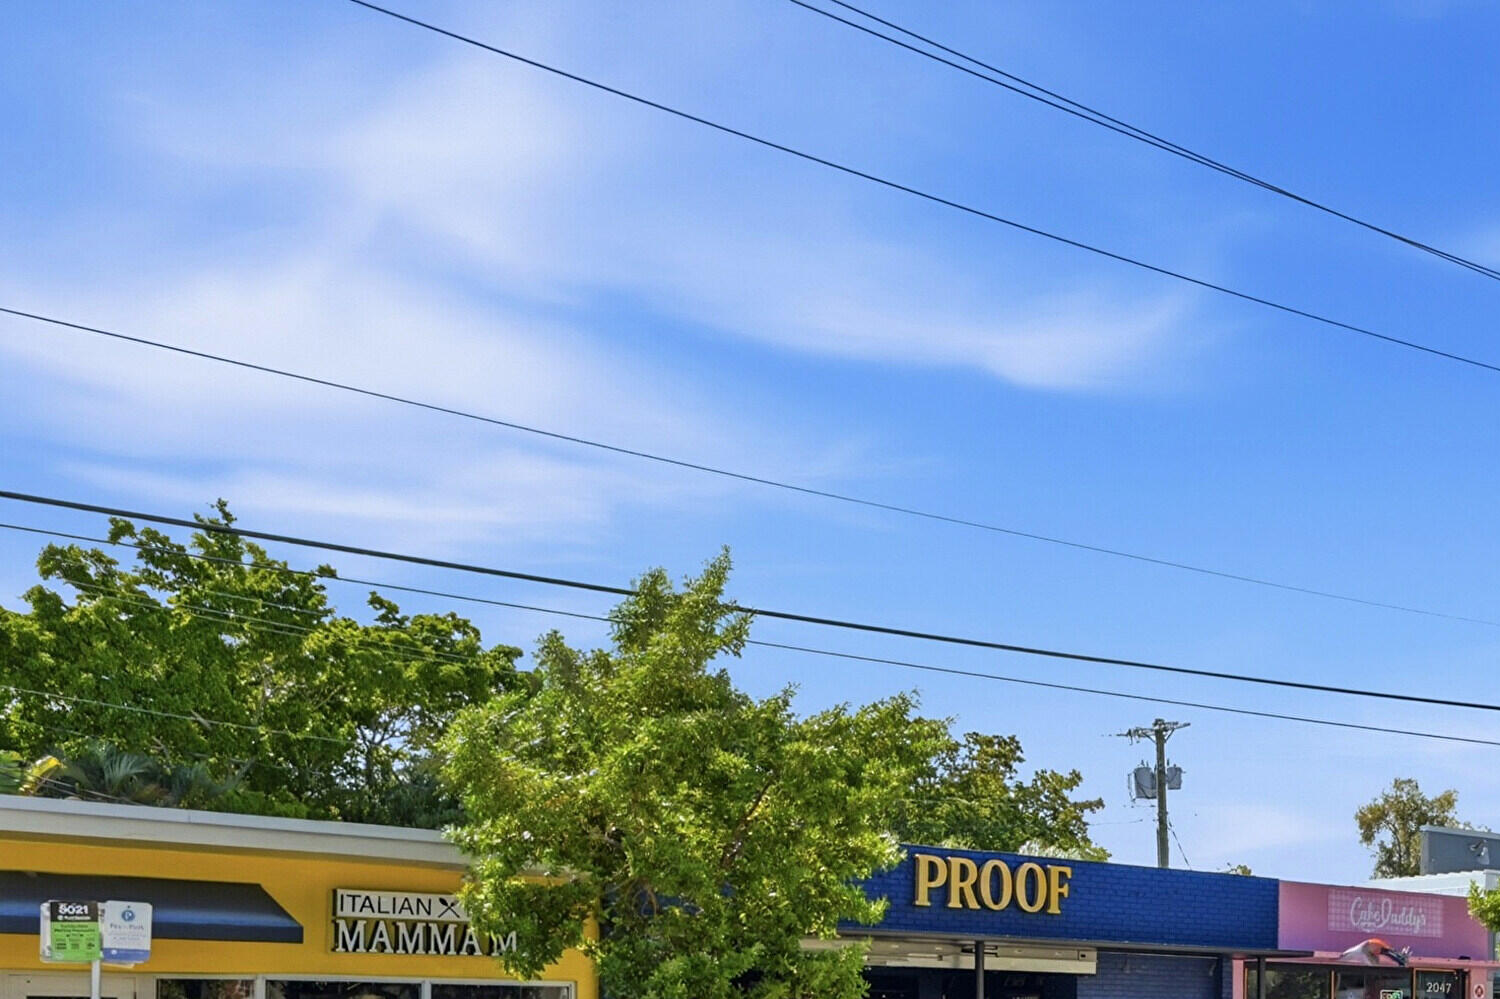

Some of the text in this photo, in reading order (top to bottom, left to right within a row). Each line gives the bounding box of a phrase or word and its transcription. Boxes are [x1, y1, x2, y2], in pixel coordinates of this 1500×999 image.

[914, 853, 1073, 915] PROOF
[339, 893, 433, 916] ITALIAN
[334, 918, 484, 957] MAMMA
[1426, 982, 1452, 994] 2047
